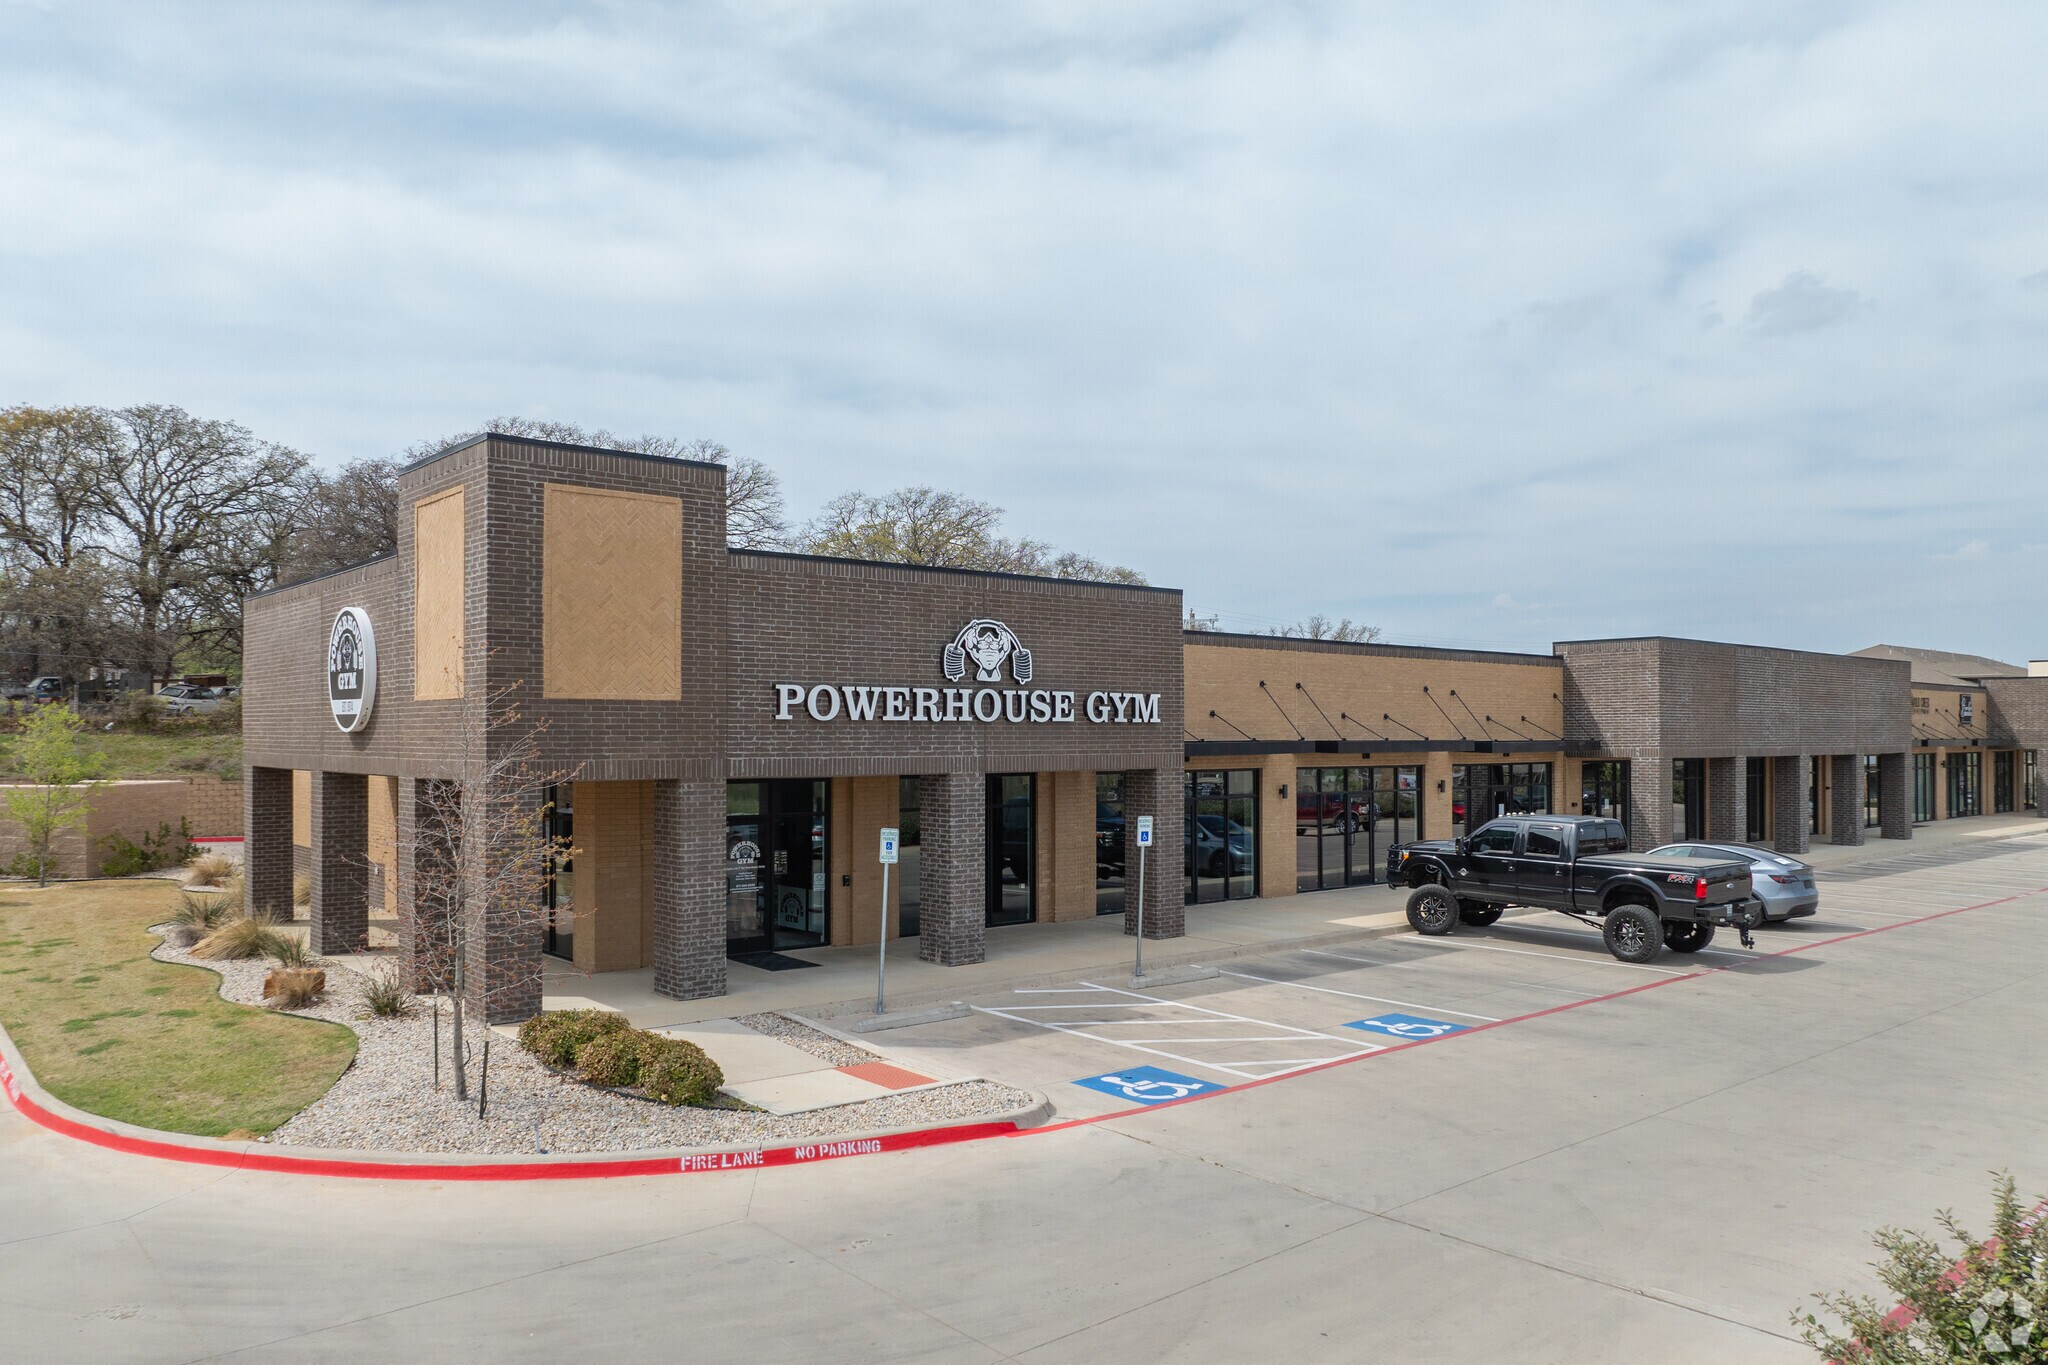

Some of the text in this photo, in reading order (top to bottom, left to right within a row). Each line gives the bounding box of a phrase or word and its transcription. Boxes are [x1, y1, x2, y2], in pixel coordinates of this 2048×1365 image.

[331, 615, 363, 673] POWERHOUSE
[338, 672, 357, 690] GYM
[774, 684, 1161, 723] POWERHOUSE GYM
[730, 841, 761, 859] POWERHOUSE
[680, 1139, 881, 1171] FIRE LANE NO PARKING
